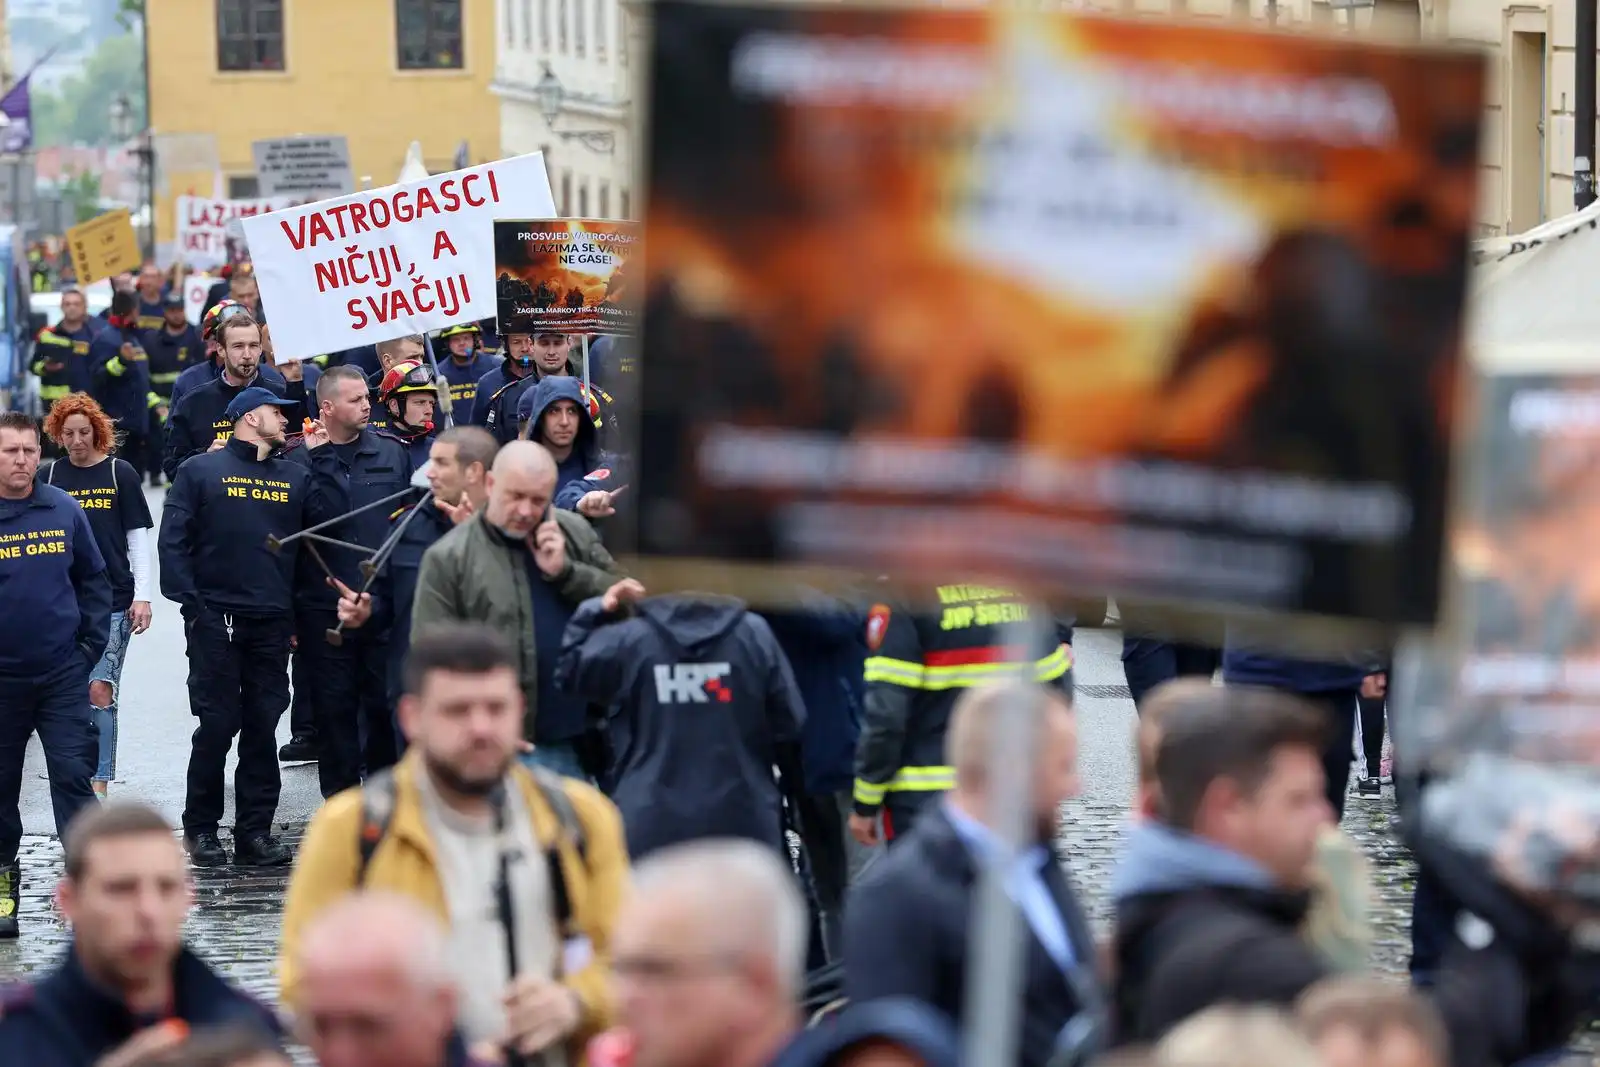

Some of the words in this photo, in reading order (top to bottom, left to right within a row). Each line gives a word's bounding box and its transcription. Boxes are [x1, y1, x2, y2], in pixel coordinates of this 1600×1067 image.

[280, 171, 501, 250] VATROGASCI
[517, 232, 569, 241] PROSVJED
[433, 231, 457, 259] A
[581, 243, 596, 253] SE
[598, 244, 631, 256] VATR
[559, 255, 575, 264] NE
[578, 254, 612, 265] GASE!
[348, 275, 471, 329] SVAČIJI
[222, 476, 252, 485] LAŽIMA
[254, 478, 264, 486] SE
[265, 479, 291, 489] VATRE
[92, 488, 116, 496] VATRE
[227, 486, 247, 498] NE
[252, 488, 289, 503] GASE
[0, 532, 26, 543] AŽIMA
[28, 531, 39, 540] SE
[40, 529, 66, 538] VATRE
[0, 546, 22, 560] NE
[26, 541, 66, 556] GASE
[653, 661, 732, 705] HRT
